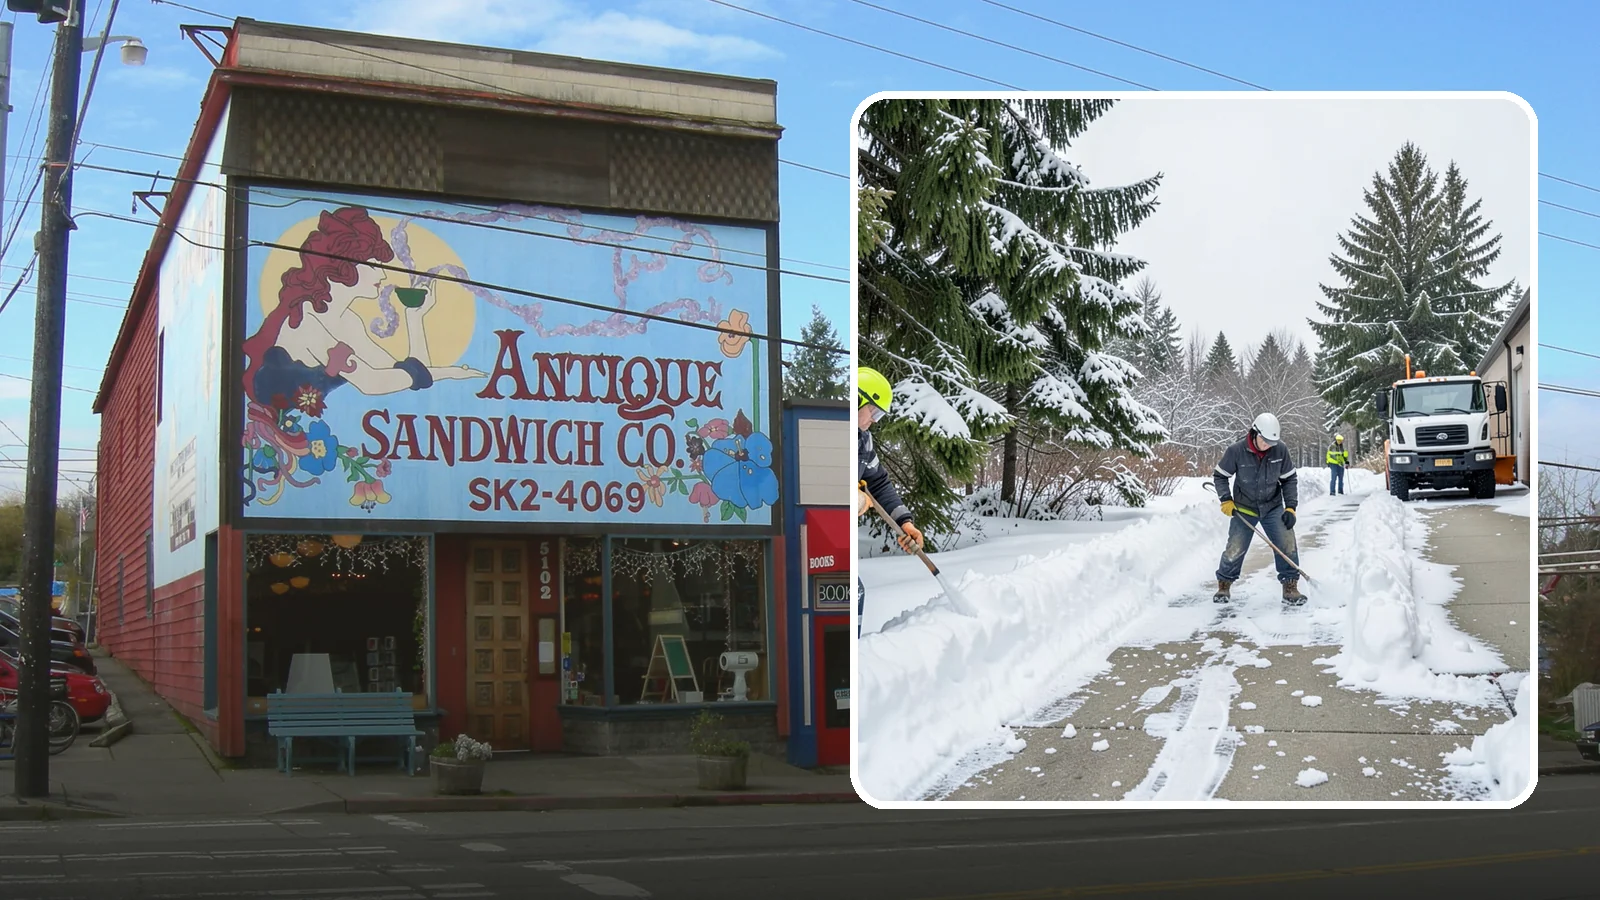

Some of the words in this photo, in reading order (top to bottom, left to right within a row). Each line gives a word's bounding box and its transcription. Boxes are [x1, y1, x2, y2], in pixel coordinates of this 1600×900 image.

[361, 408, 605, 468] SANDWICH
[617, 421, 685, 469] CO.
[468, 477, 646, 513] SK2-4069
[539, 541, 551, 600] 5102
[809, 555, 835, 569] BOOKS
